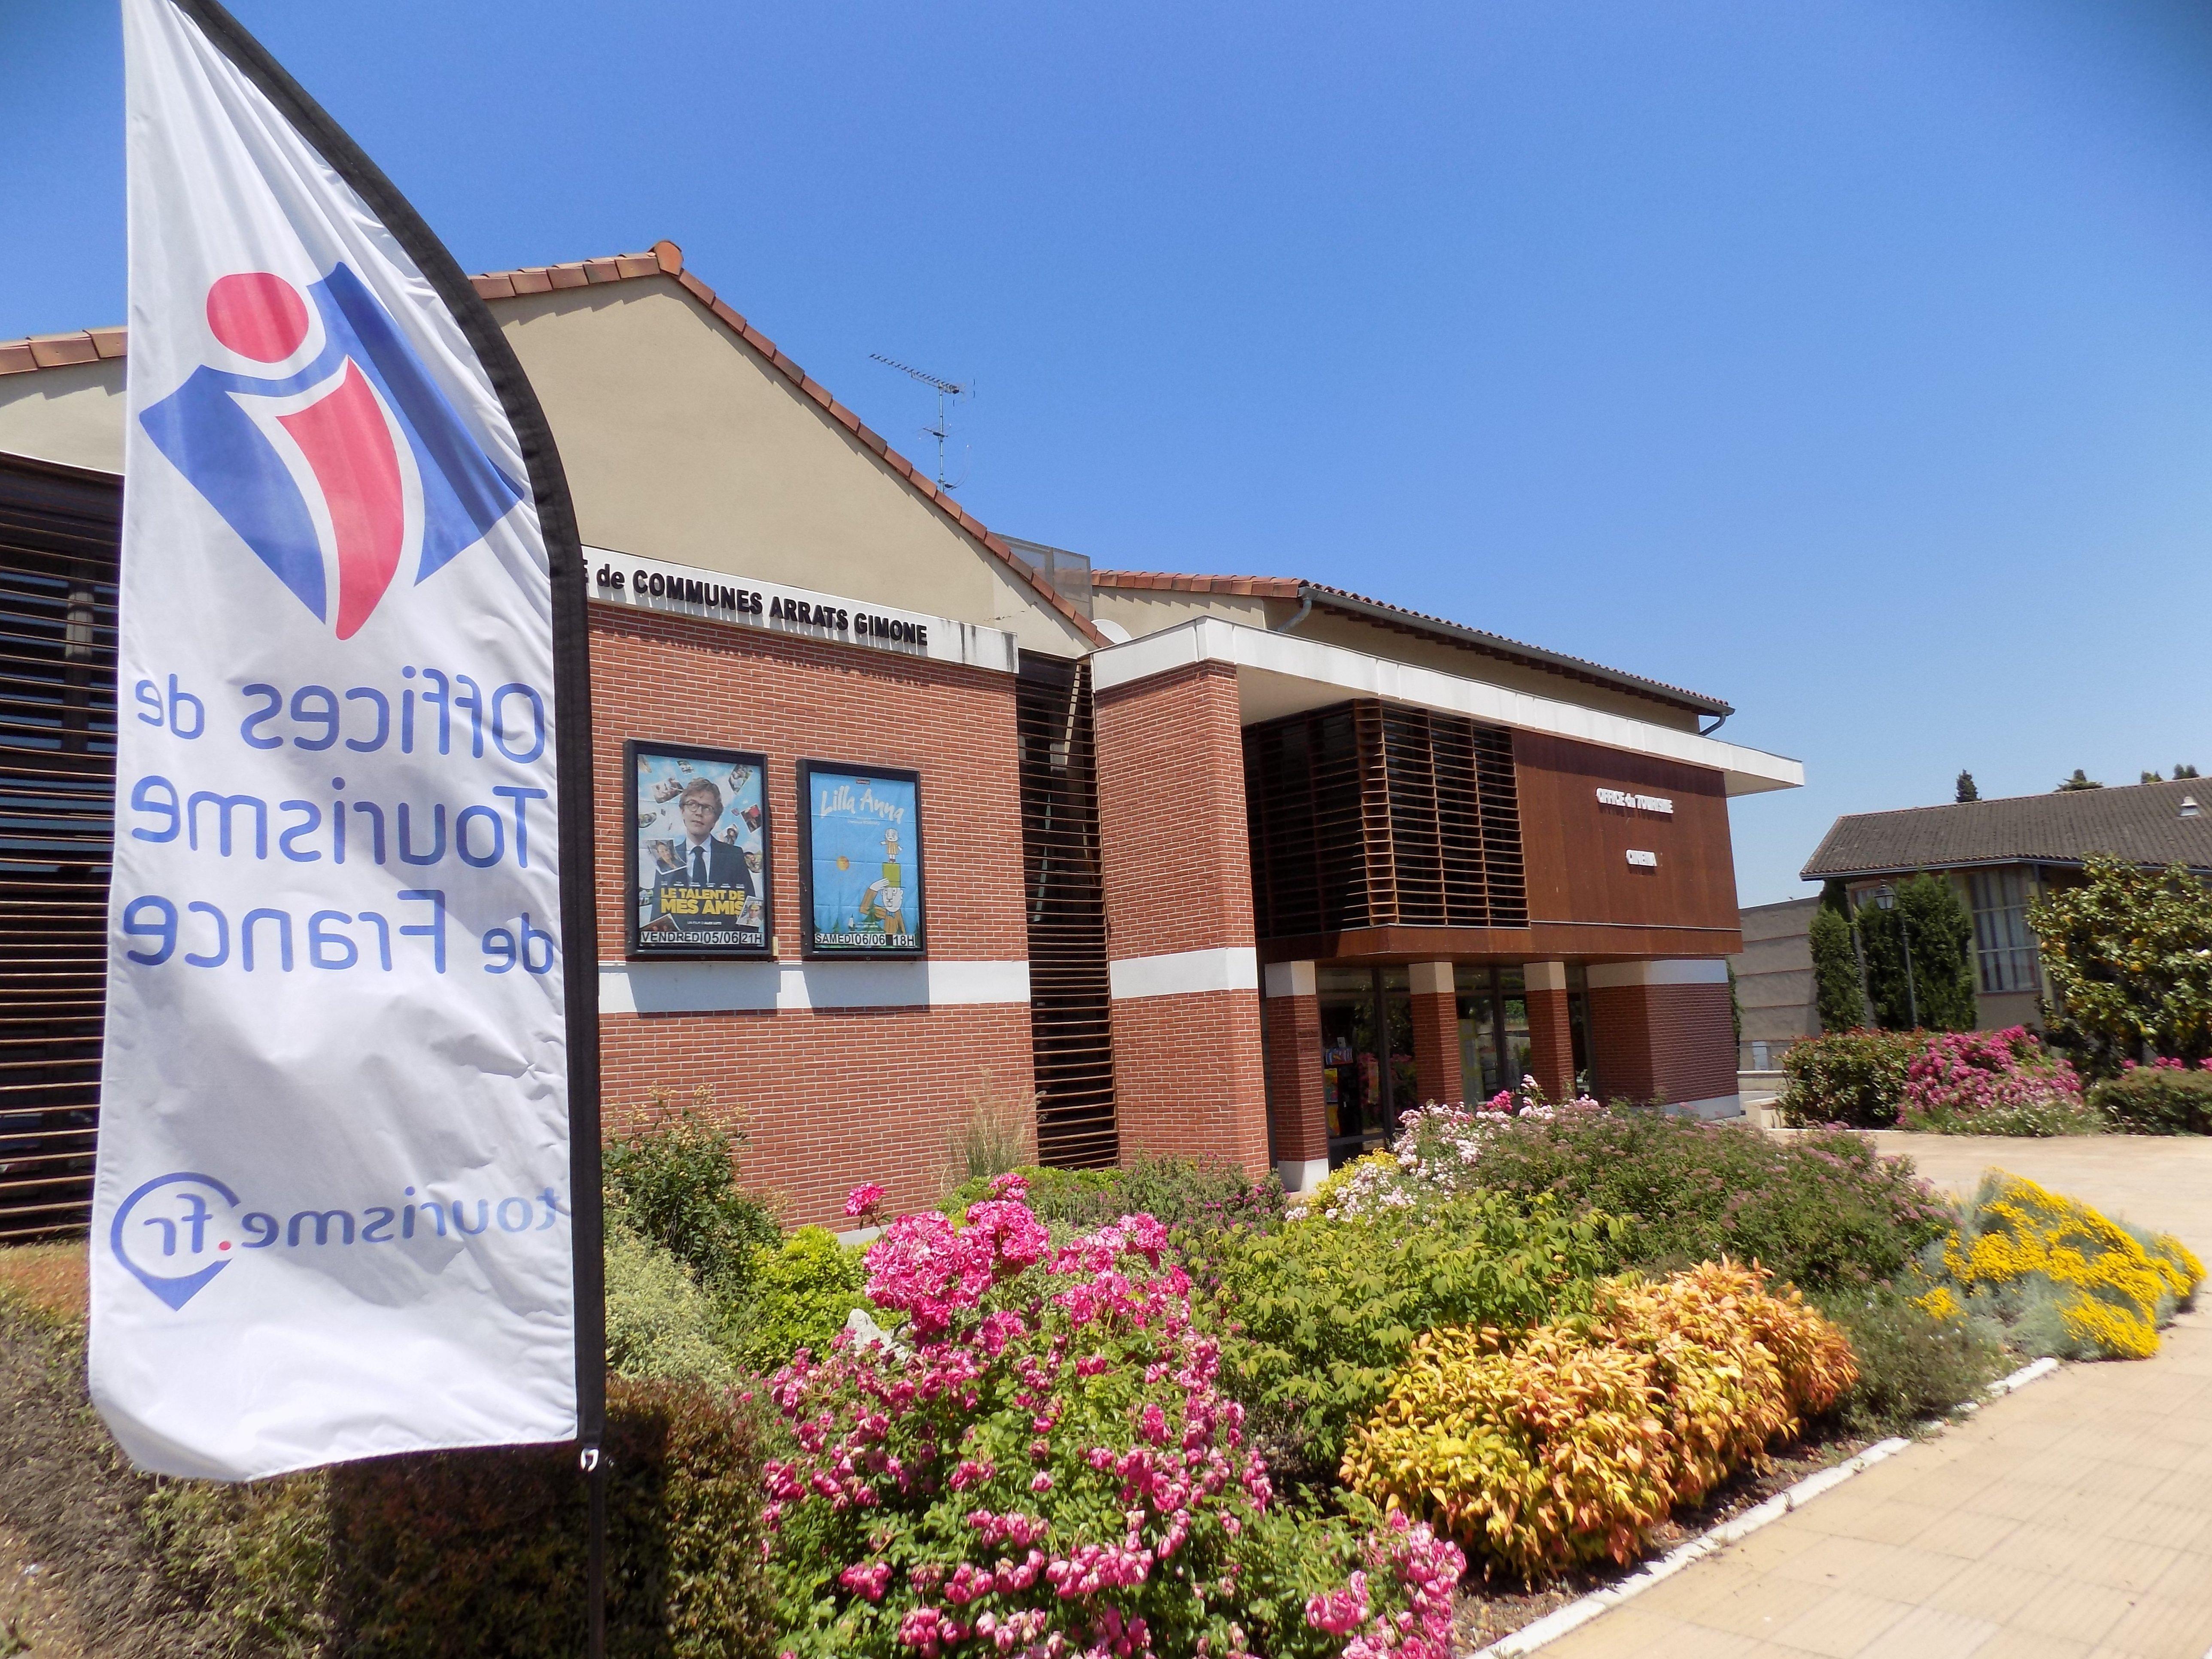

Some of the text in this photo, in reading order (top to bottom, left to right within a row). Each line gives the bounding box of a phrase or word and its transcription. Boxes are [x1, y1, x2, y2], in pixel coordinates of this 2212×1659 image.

[596, 563, 625, 589] de
[632, 569, 763, 615] COMMUNES
[769, 596, 849, 631] ARRATS
[854, 613, 928, 646] GIMONE
[820, 785, 904, 824] Lilla Anna
[1635, 794, 1674, 814] TOURISE
[661, 888, 745, 901] LE TALENT DE
[661, 899, 744, 915] MES AMIS
[642, 931, 763, 944] VENDREDI 05/06 21H
[816, 934, 915, 945] SAMEDI 06/06 18H
